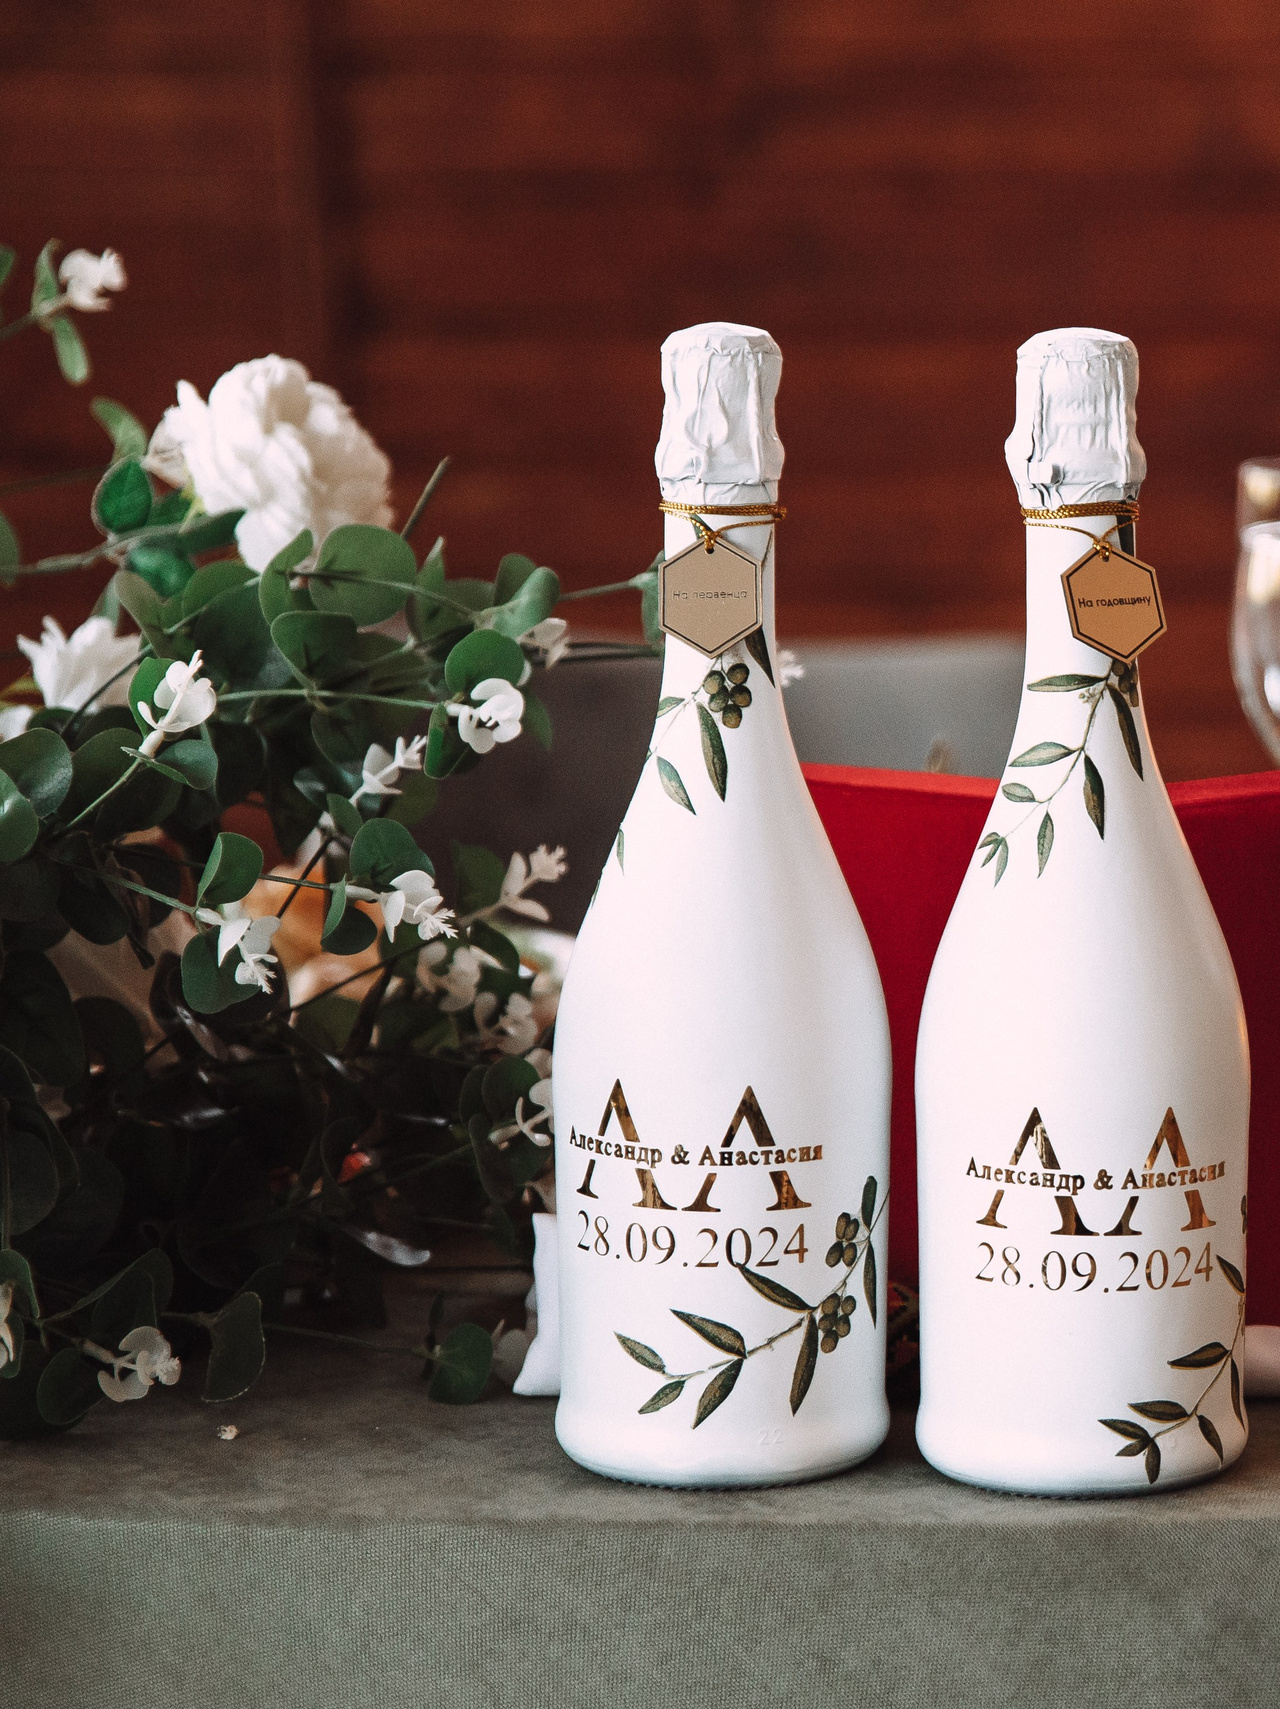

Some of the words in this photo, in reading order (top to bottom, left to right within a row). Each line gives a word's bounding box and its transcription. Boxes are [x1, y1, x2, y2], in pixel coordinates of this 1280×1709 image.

[673, 590, 688, 600] На
[1077, 597, 1094, 608] На
[1096, 596, 1151, 607] годовщину
[569, 1124, 663, 1169] Александр
[671, 1143, 690, 1165] &
[698, 1144, 823, 1166] Анастасия
[966, 1156, 1085, 1195] Александр
[1093, 1169, 1113, 1190] &
[576, 1209, 809, 1269] 28.09.2024
[975, 1241, 1214, 1293] 28.09.2024
